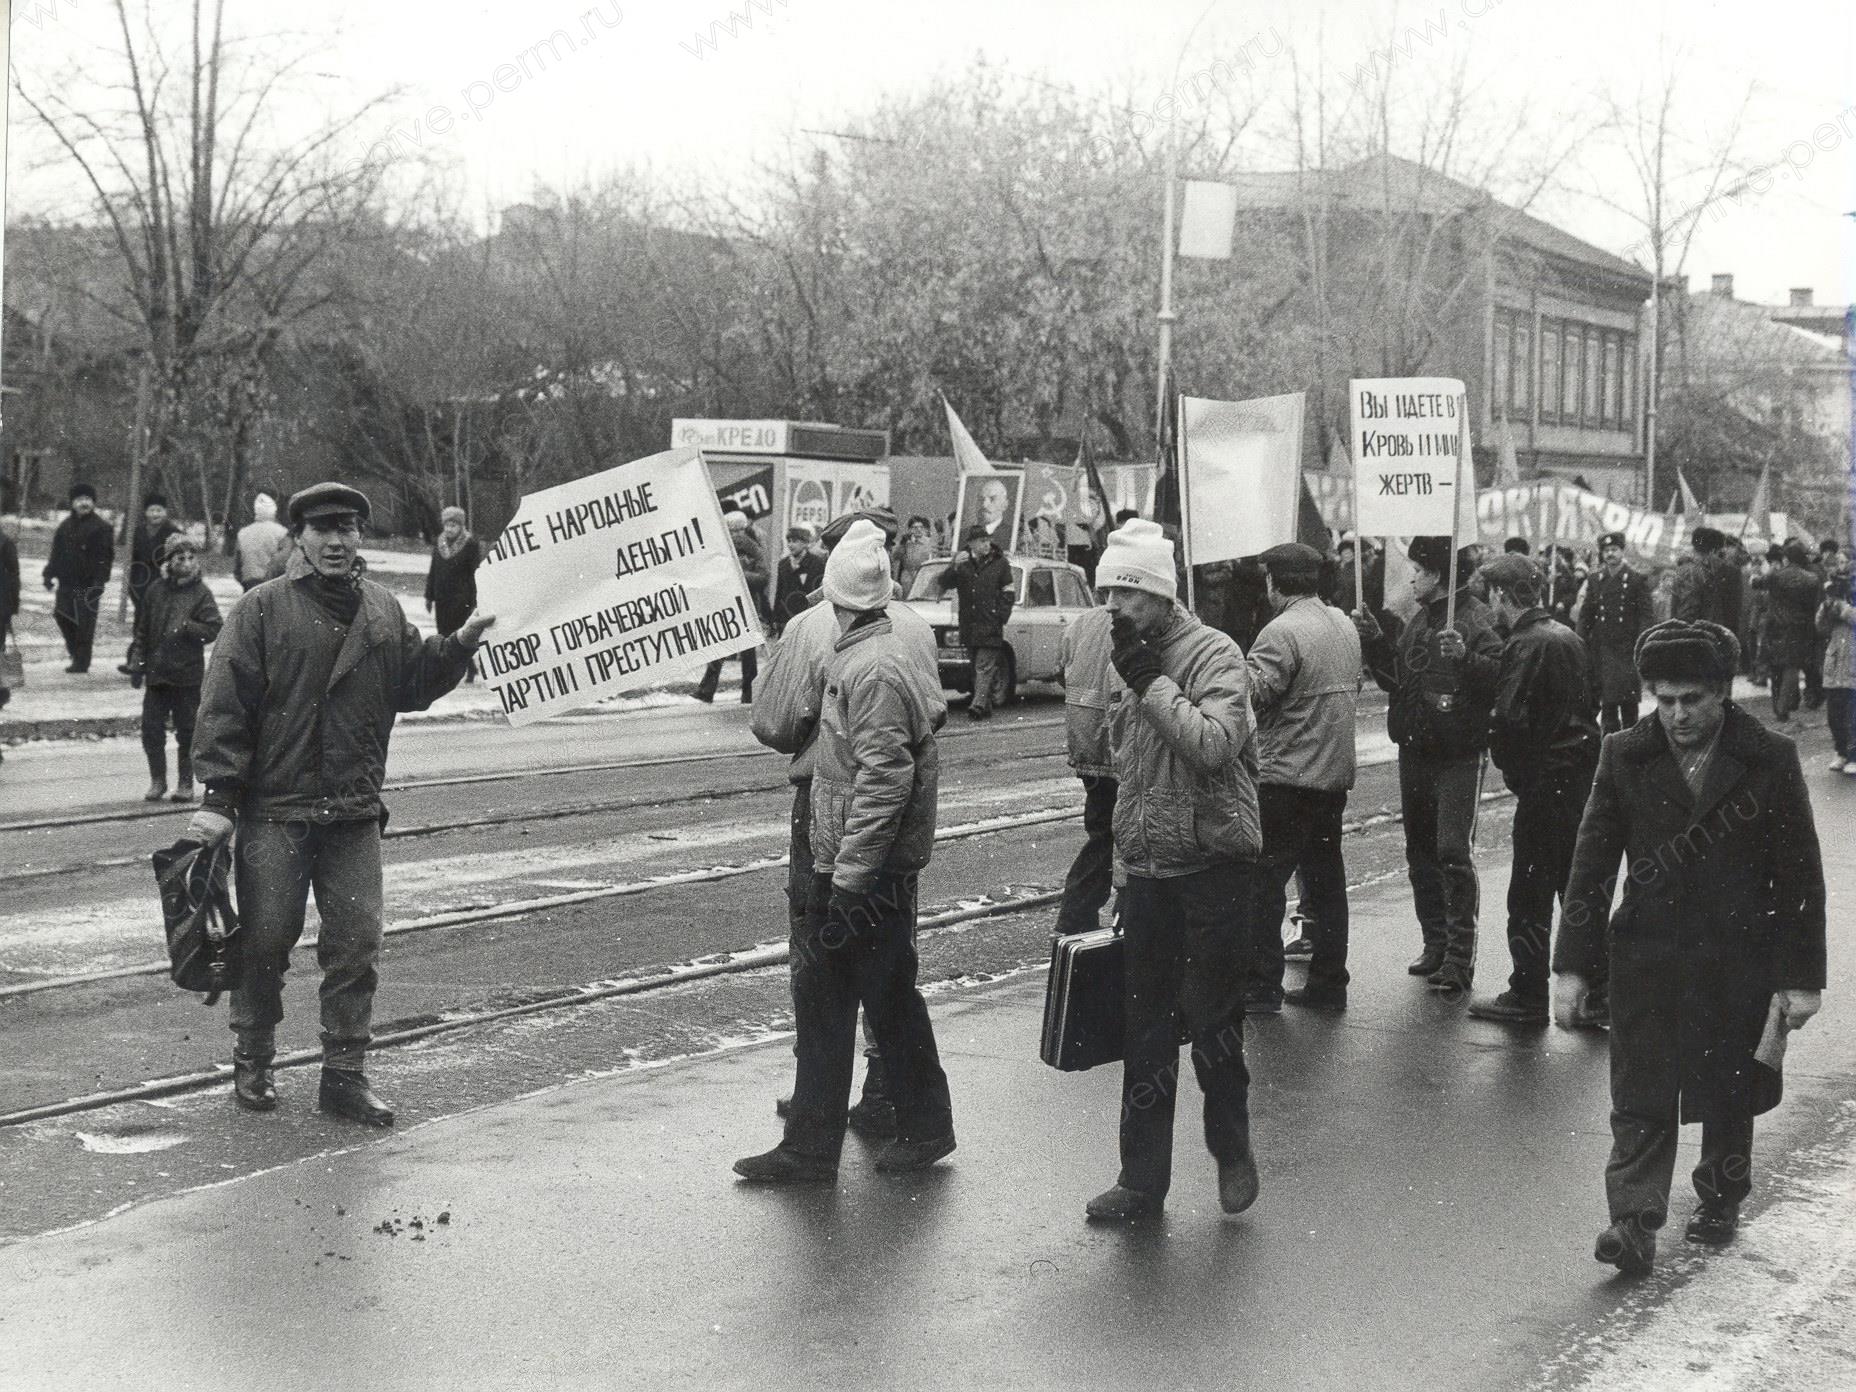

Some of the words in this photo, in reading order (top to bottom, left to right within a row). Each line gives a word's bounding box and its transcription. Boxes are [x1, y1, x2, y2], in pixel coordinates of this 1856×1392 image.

[1360, 391, 1388, 419] ВЫ
[1396, 394, 1443, 419] ИДЕТЕ
[1362, 430, 1414, 457] КРОВЬ
[545, 482, 659, 544] НАРОДНЫЕ
[1379, 472, 1433, 495] ЖЕРТВ
[615, 516, 706, 580] ДЕНЬГИ!
[478, 632, 541, 680] ПОЗОР
[550, 582, 690, 654] ГОРБАЧЕВСКОЙ
[584, 595, 751, 685] ПРЕСТУПНИКОВ!
